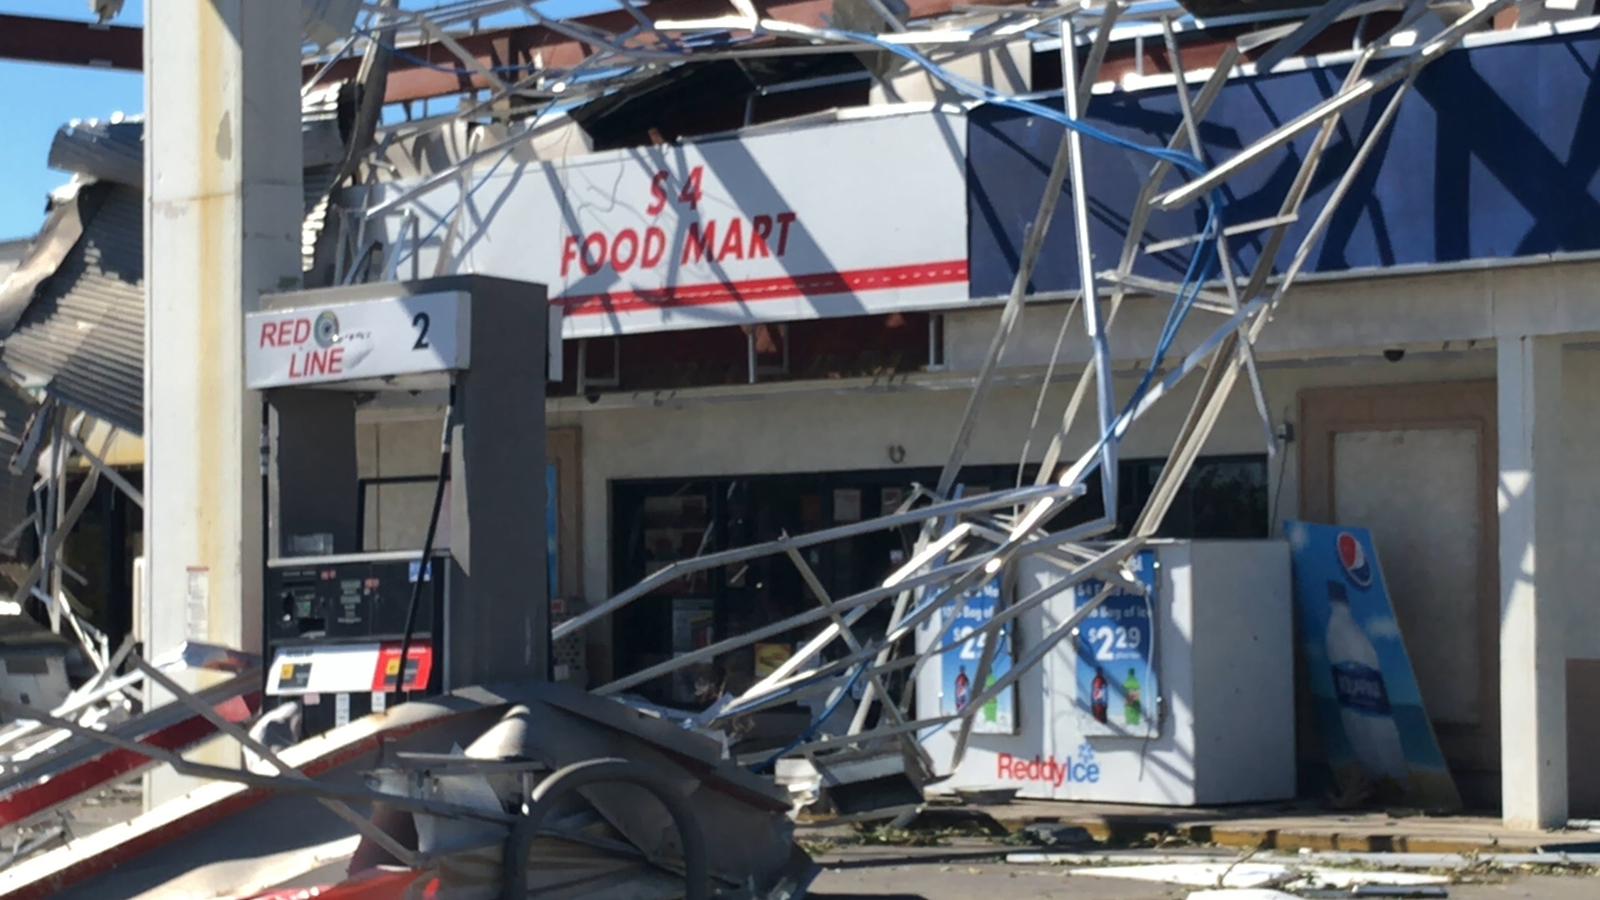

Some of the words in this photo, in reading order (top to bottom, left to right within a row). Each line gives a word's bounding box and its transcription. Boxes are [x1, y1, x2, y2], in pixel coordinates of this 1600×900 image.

[646, 169, 669, 216] S
[679, 165, 705, 211] 4
[560, 226, 667, 277] FOOD
[681, 211, 797, 266] MART
[259, 318, 311, 348] RED
[411, 311, 431, 350] 2
[288, 347, 345, 379] LINE
